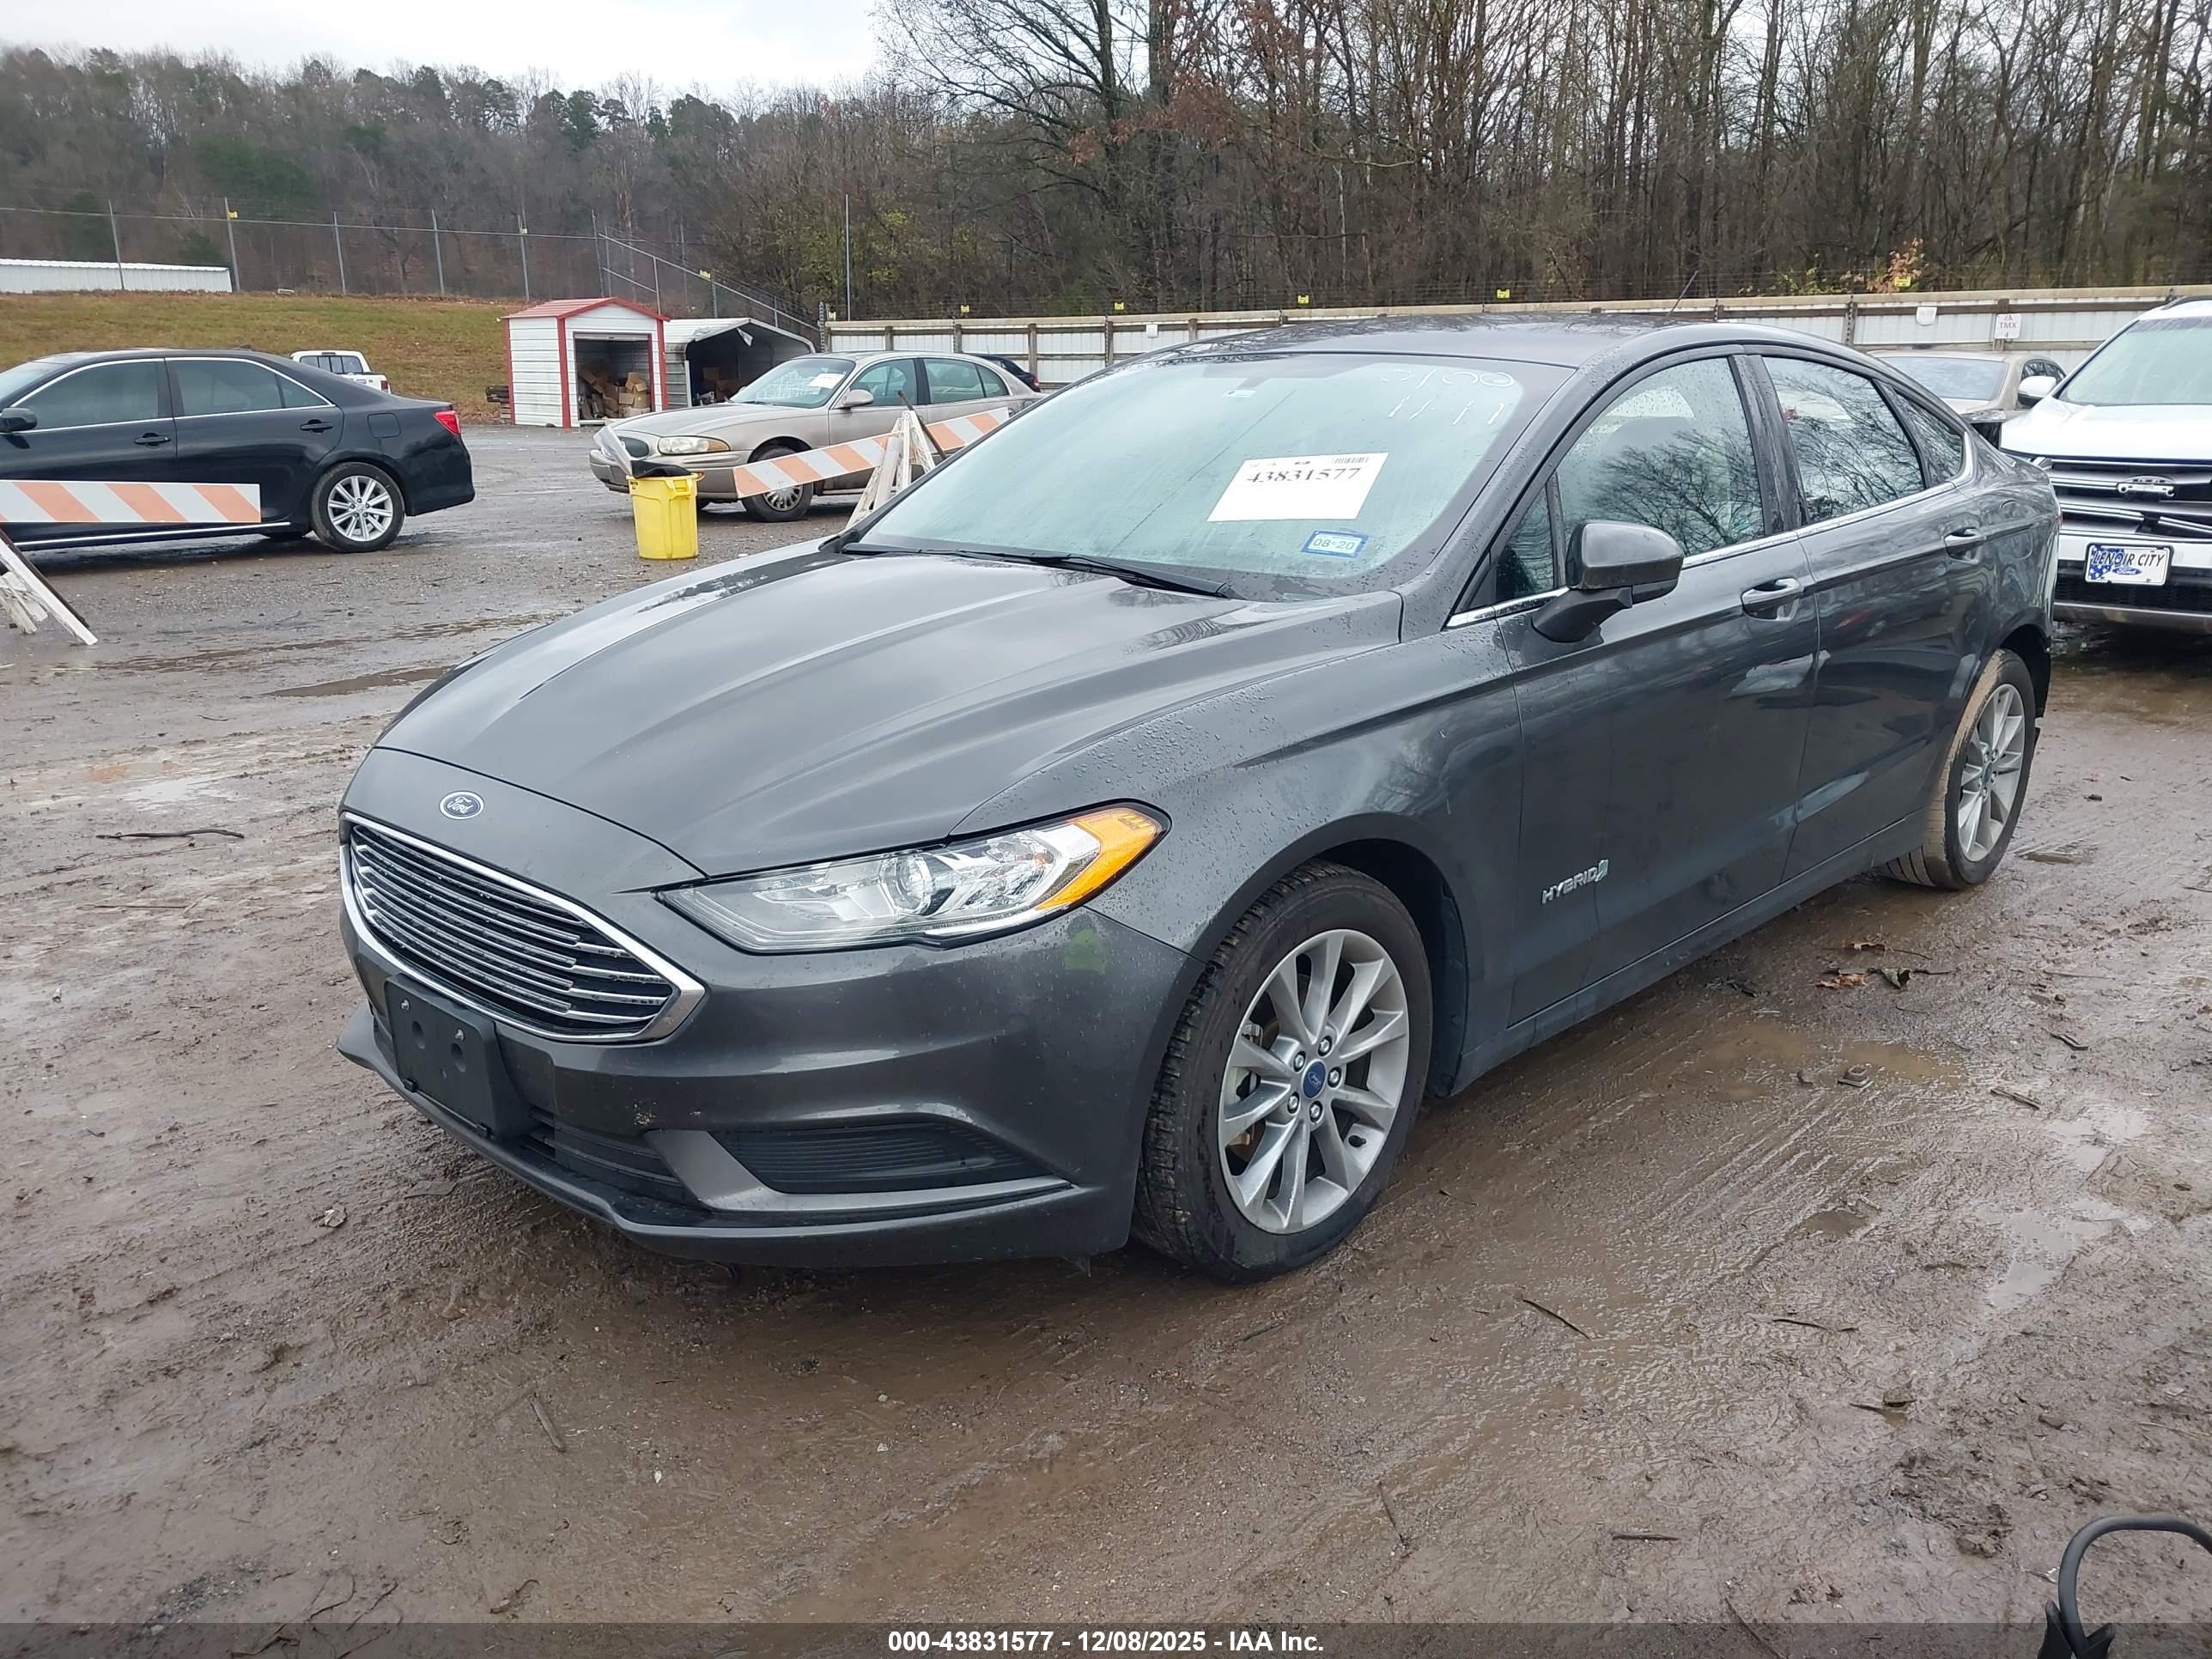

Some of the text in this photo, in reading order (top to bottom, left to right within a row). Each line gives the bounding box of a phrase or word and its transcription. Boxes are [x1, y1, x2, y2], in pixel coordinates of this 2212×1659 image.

[1247, 467, 1362, 483] 43831577
[2093, 550, 2166, 567] LENOIR CITY
[447, 796, 473, 814] Ford
[1541, 866, 1598, 904] HYBRID
